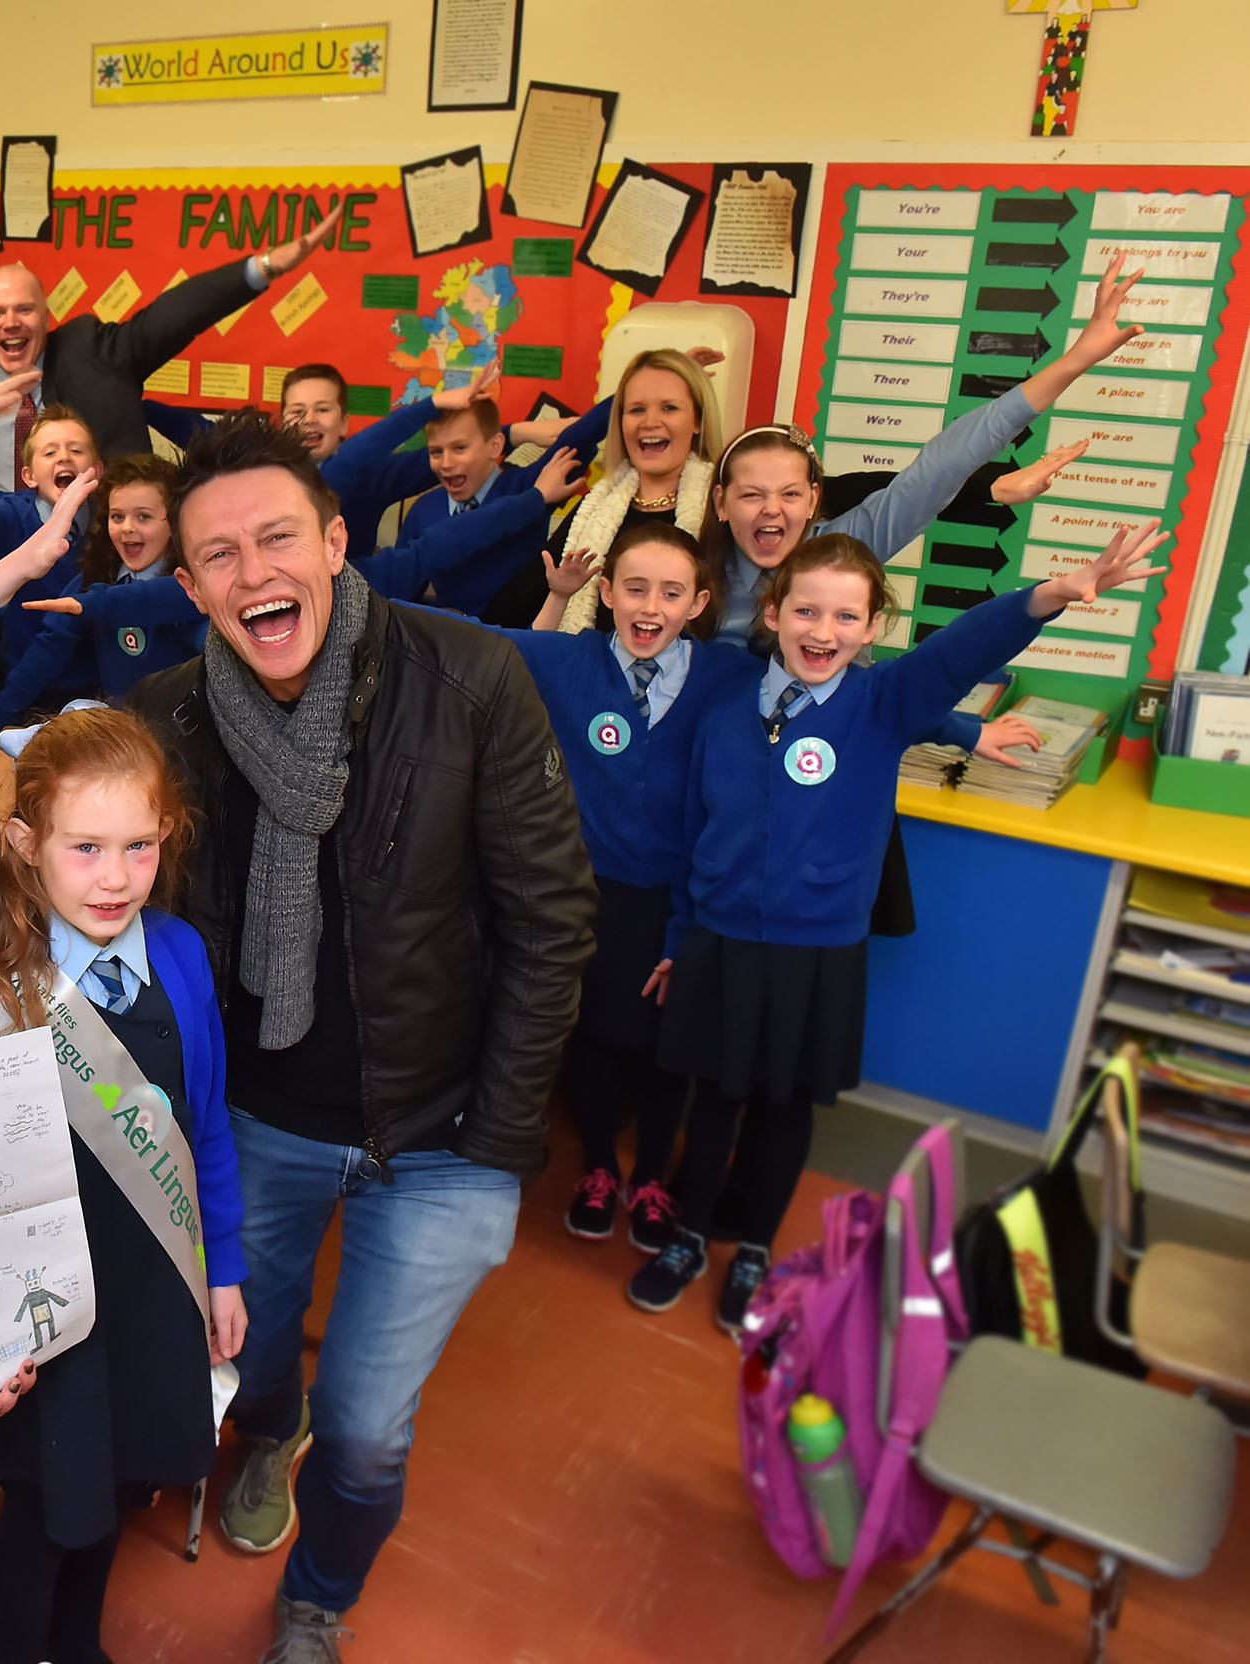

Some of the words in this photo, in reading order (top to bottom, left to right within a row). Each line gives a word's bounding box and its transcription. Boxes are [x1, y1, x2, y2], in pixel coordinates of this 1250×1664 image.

[123, 49, 199, 82] World
[207, 43, 305, 76] Around
[315, 40, 349, 70] Us
[897, 202, 941, 216] You're
[1136, 203, 1161, 216] You
[1164, 205, 1187, 216] are
[51, 193, 138, 250] THE
[178, 191, 378, 252] FAMINE
[895, 247, 928, 259] Your
[1100, 246, 1111, 256] It
[1167, 248, 1181, 257] to
[1182, 249, 1208, 260] you
[881, 291, 930, 304] They're
[1122, 295, 1144, 307] hey
[1147, 297, 1170, 306] are
[881, 335, 917, 347] Their
[1125, 339, 1155, 351] ongs
[1159, 340, 1172, 349] to
[1113, 354, 1146, 365] them
[872, 375, 911, 387] There
[1096, 387, 1106, 398] A
[1109, 387, 1145, 400] place
[865, 415, 903, 427] We're
[1091, 431, 1109, 442] We
[1112, 433, 1134, 443] are
[862, 454, 895, 467] Were
[1053, 470, 1081, 483] Past
[1084, 473, 1117, 486] tense
[1120, 475, 1134, 487] of
[1136, 479, 1158, 488] are
[1050, 515, 1060, 523] A
[1062, 516, 1094, 528] point
[1097, 518, 1109, 527] in
[1050, 554, 1059, 563] A
[1062, 554, 1093, 565] meth
[1110, 607, 1119, 616] 2
[1025, 644, 1072, 656] ndicates
[1075, 648, 1117, 661] motion
[601, 726, 617, 743] Q
[800, 753, 820, 772] Q
[54, 1002, 78, 1030] flies
[47, 1011, 96, 1083] ingus
[111, 1105, 158, 1159] Aer
[149, 1150, 200, 1246] Lingus
